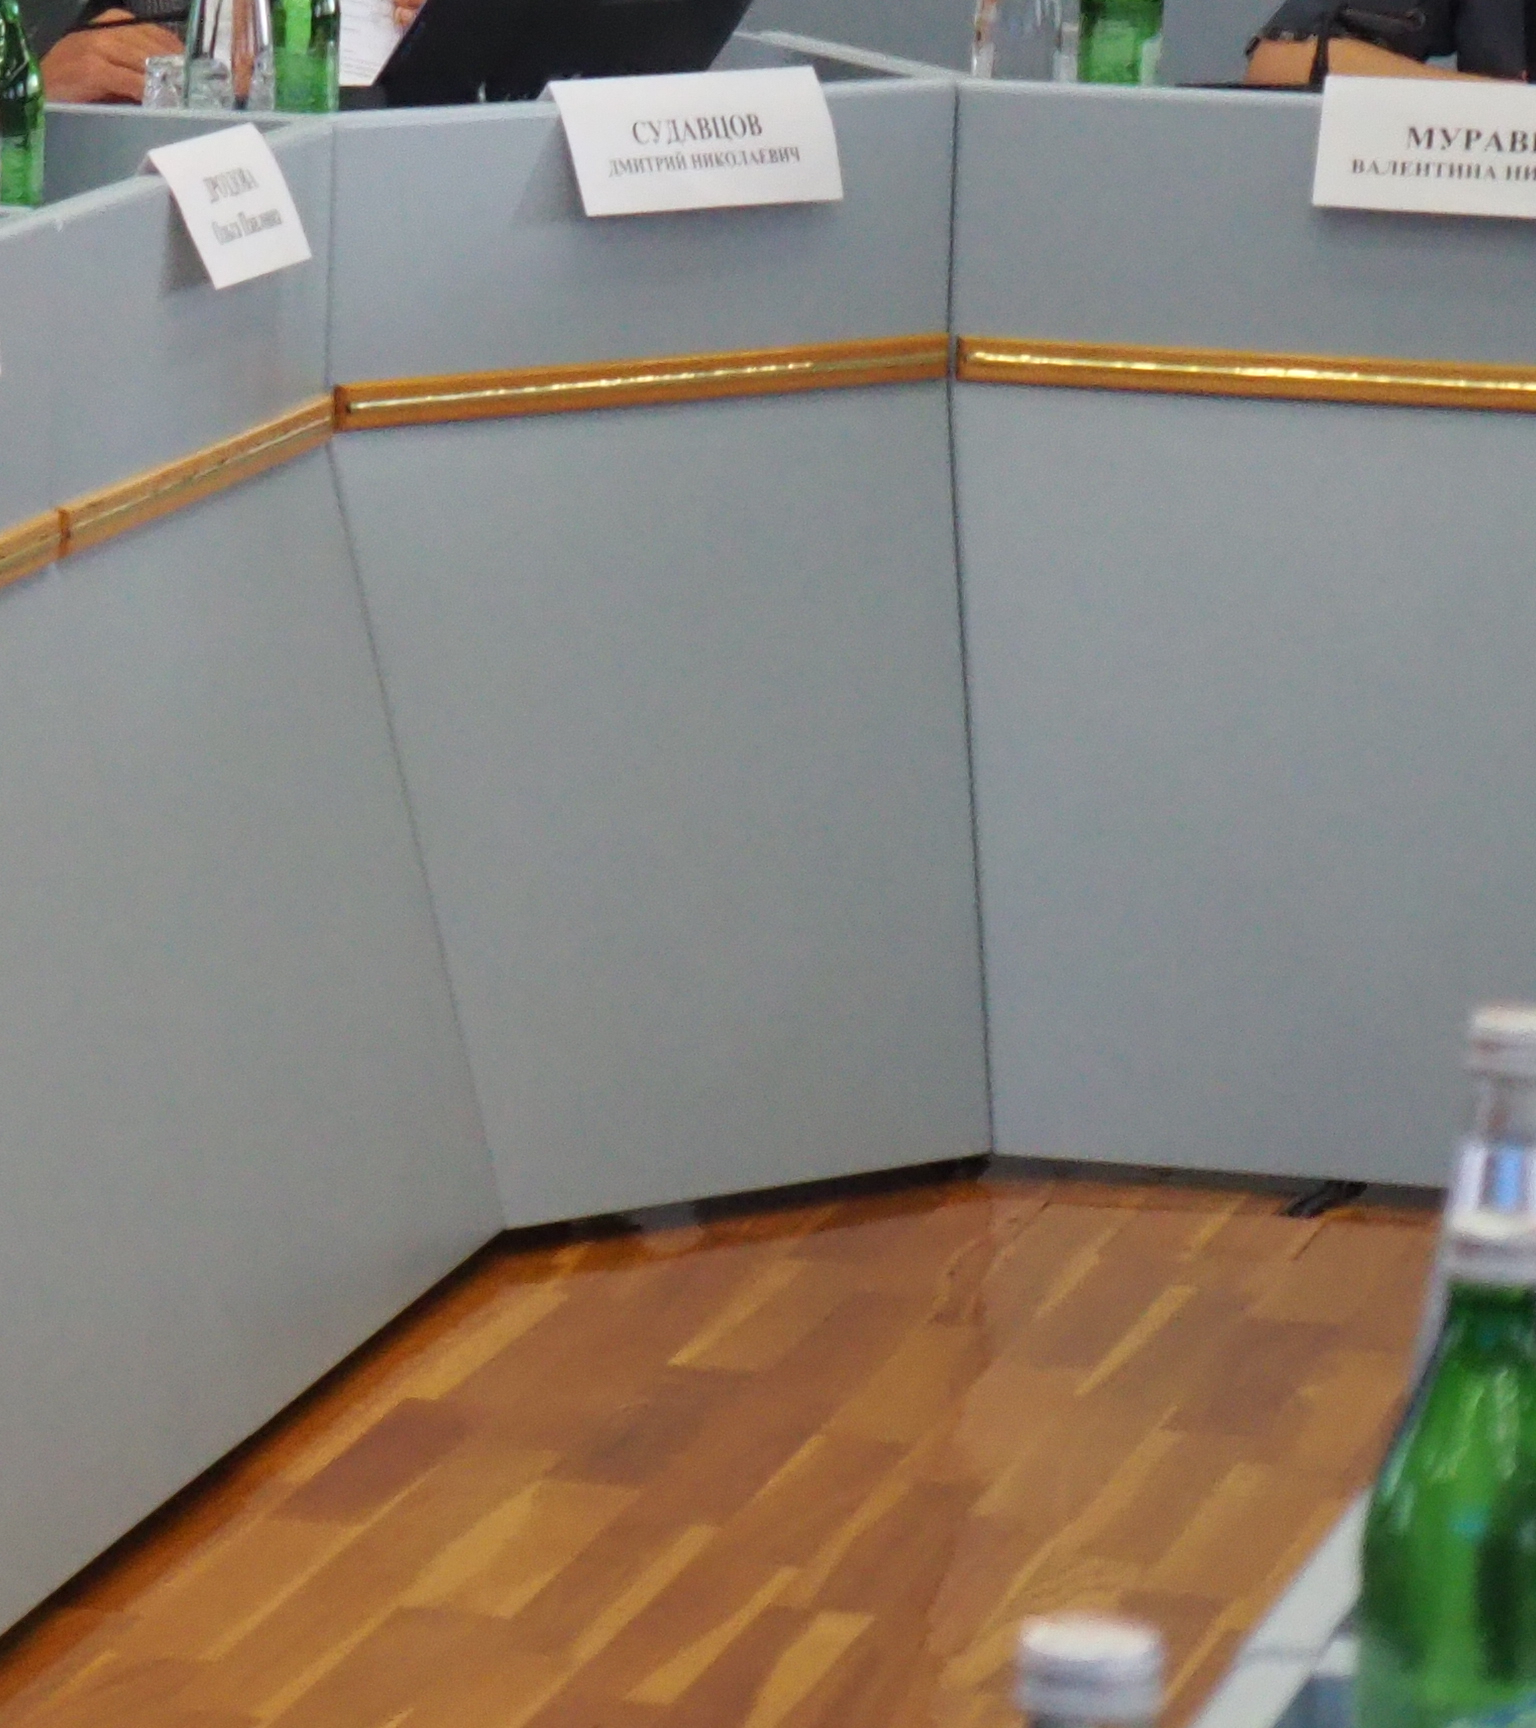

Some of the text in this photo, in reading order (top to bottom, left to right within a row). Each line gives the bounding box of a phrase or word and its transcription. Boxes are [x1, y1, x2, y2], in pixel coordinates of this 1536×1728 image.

[632, 113, 763, 145] СУДАВЦОВ
[1407, 126, 1536, 153] МУРАВ
[608, 146, 801, 177] ДМИТРИЙ НИКОЛАЕВИЧ
[1352, 158, 1497, 180] ВАЛЕНТИНА
